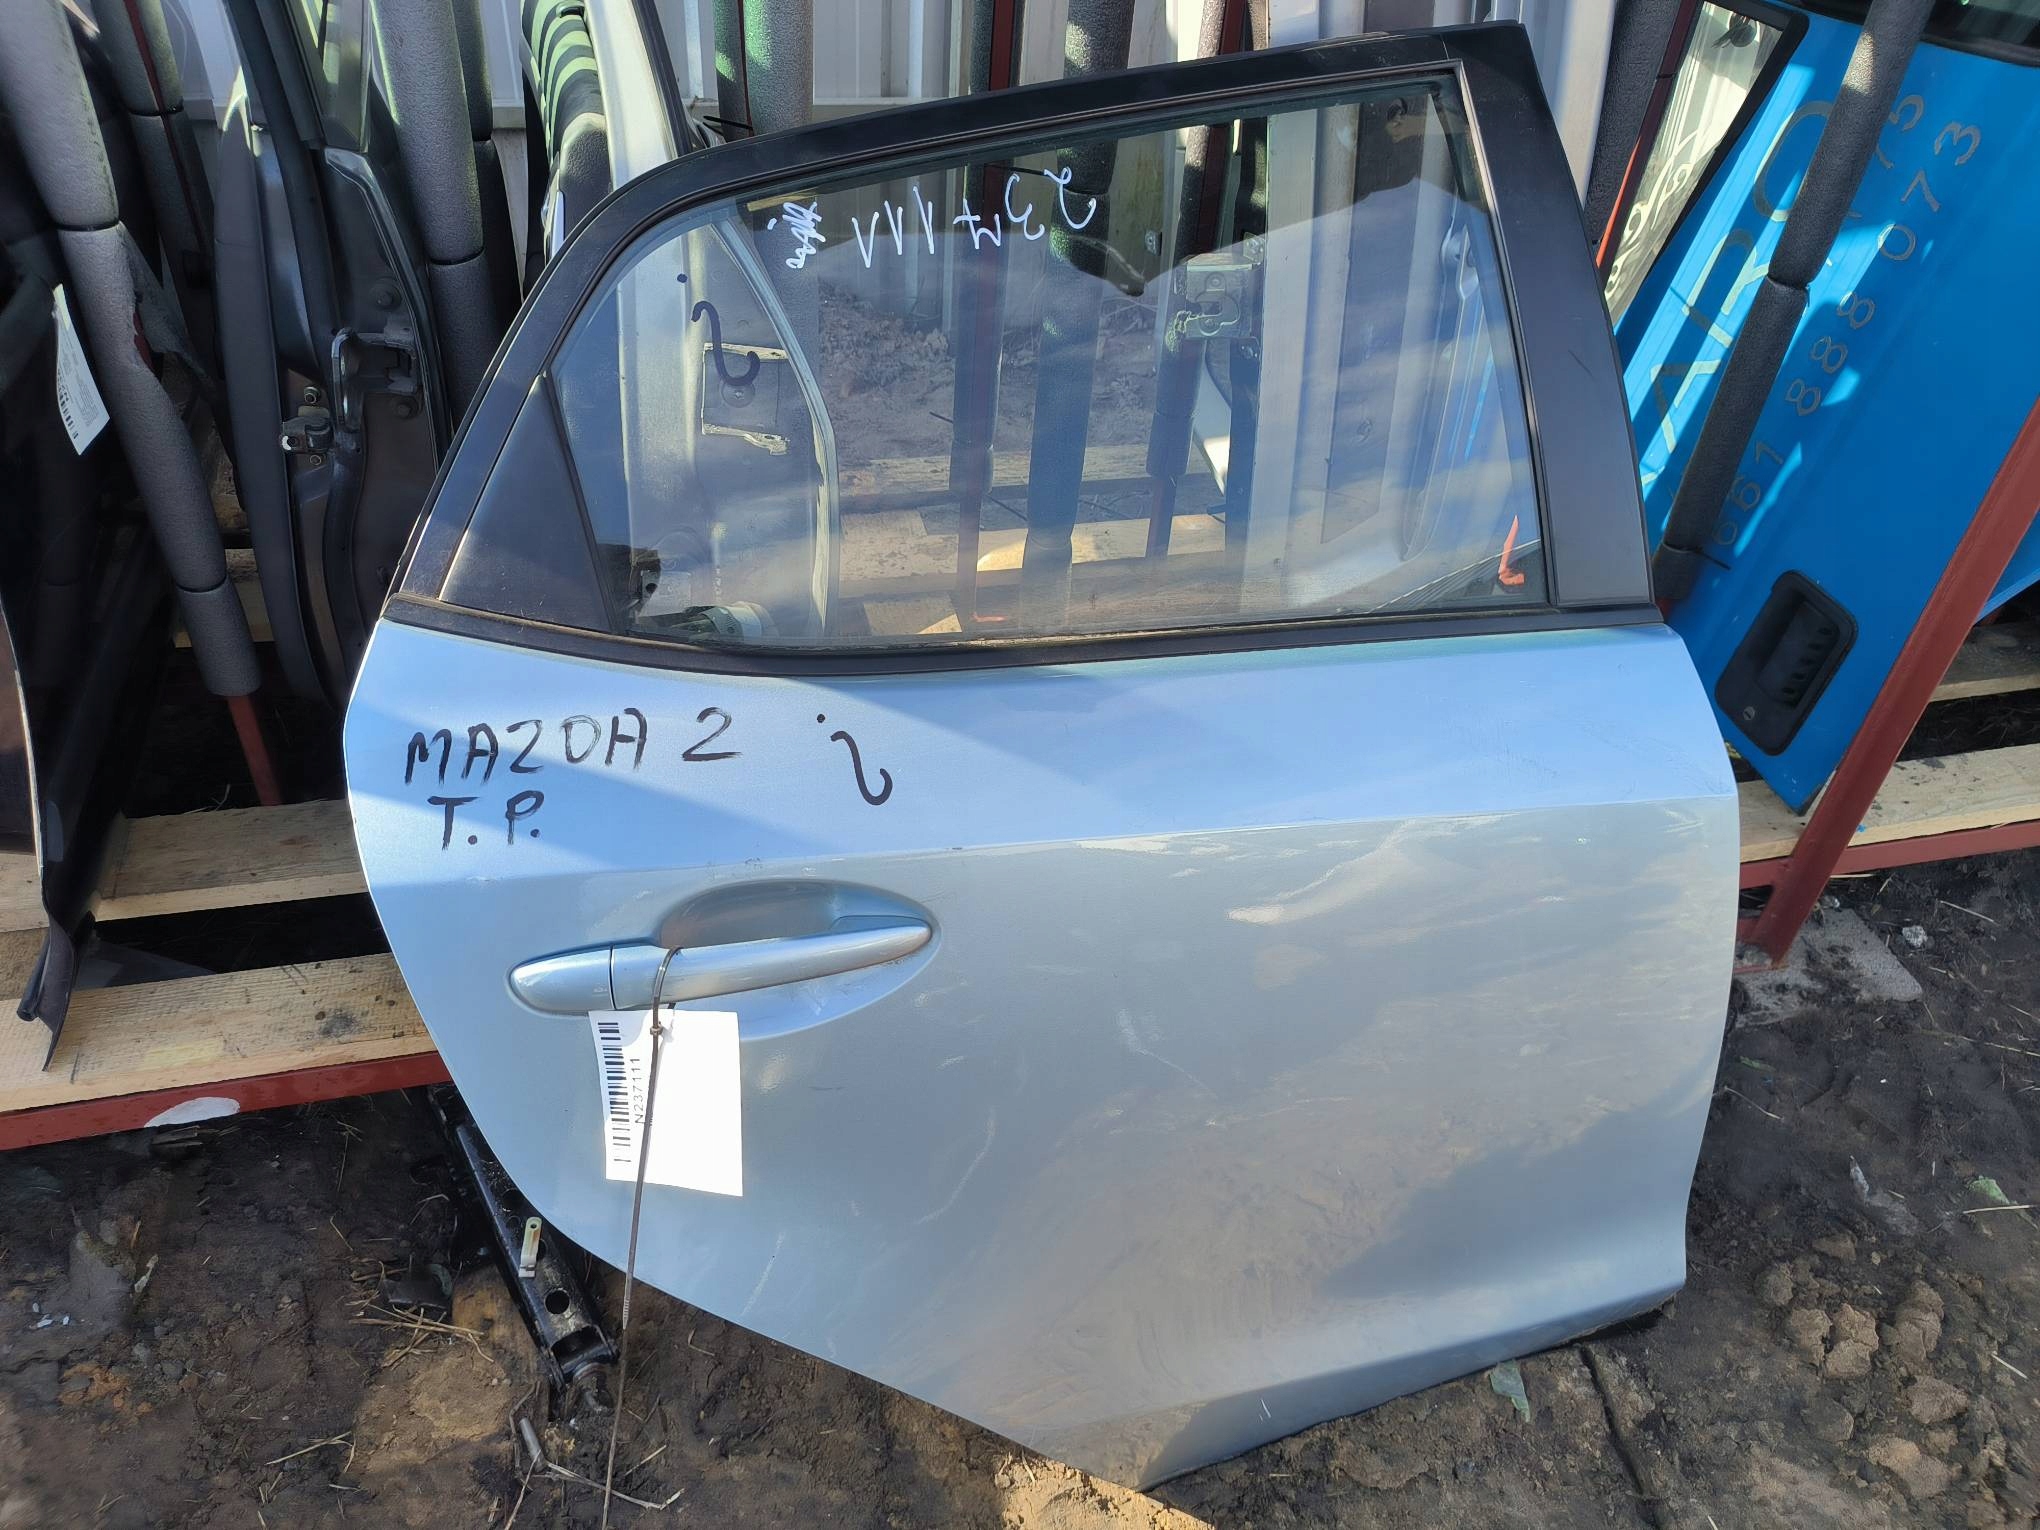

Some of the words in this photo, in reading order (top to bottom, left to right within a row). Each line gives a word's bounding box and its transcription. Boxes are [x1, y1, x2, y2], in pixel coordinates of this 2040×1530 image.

[1785, 290, 1876, 417] 888
[1877, 121, 1982, 262] 073
[682, 706, 743, 763] 2
[629, 1057, 646, 1125] N237111
